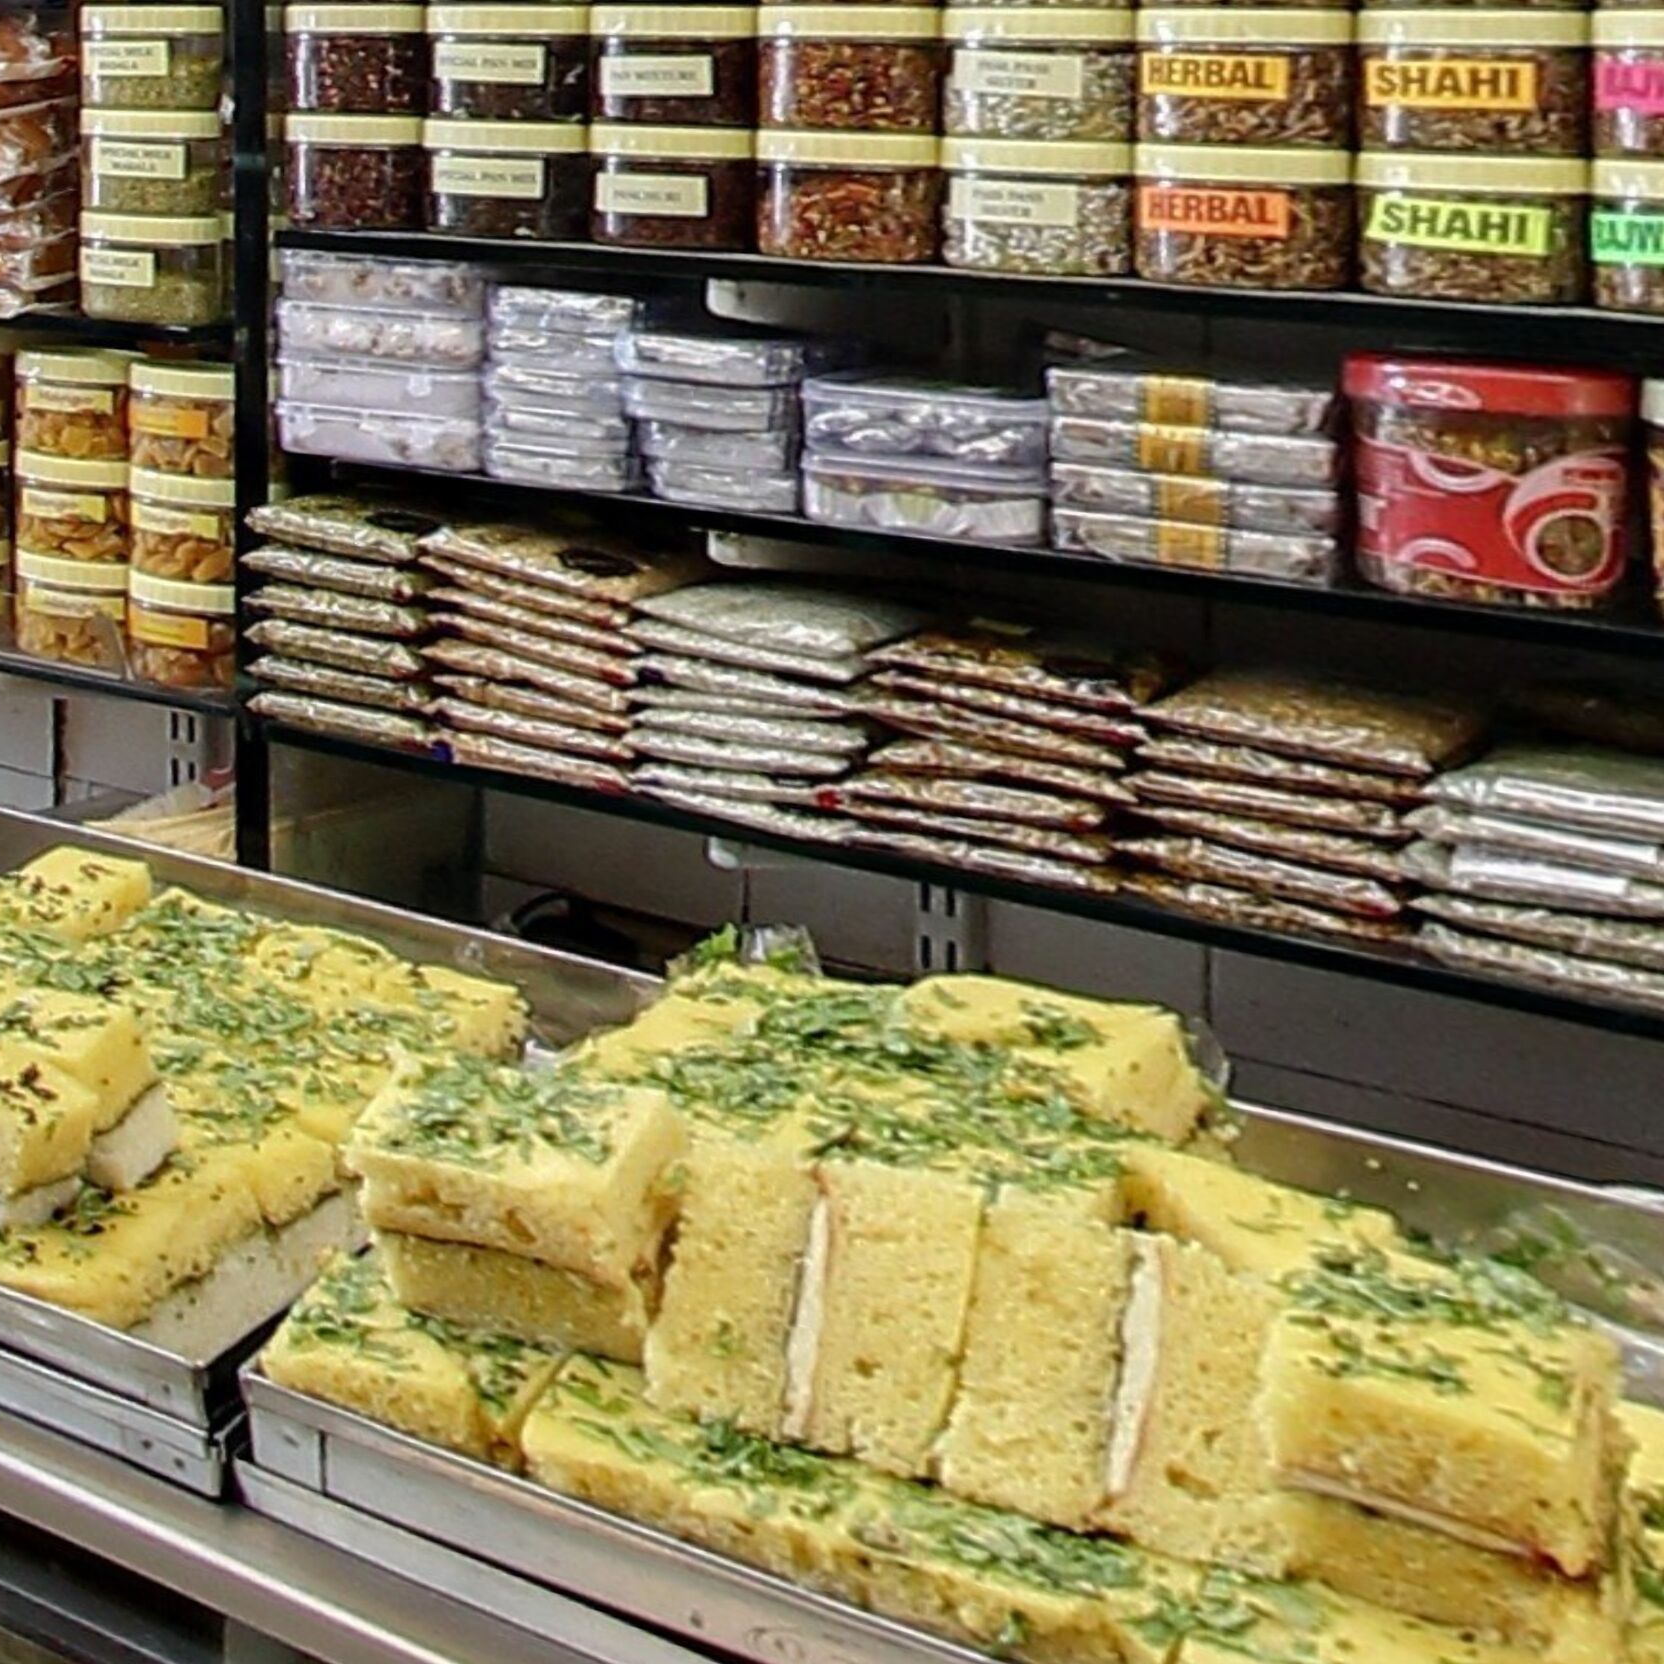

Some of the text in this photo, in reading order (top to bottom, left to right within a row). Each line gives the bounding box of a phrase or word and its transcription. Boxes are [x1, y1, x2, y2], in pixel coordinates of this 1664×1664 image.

[1147, 56, 1275, 88] HERBAL
[1375, 64, 1521, 98] SHAHI
[1147, 193, 1279, 226] HERBAL
[1379, 200, 1530, 244] SHAHI
